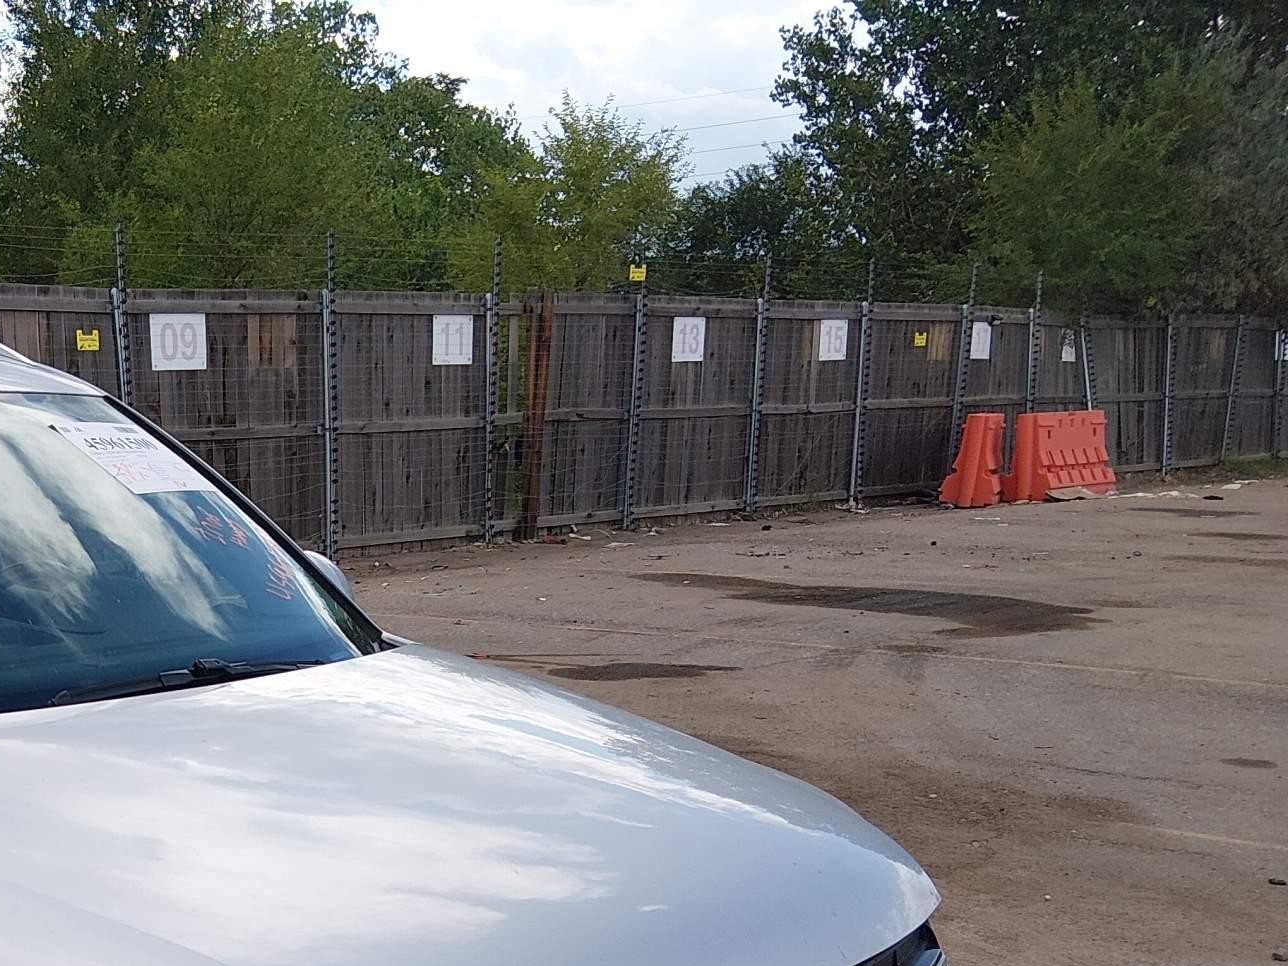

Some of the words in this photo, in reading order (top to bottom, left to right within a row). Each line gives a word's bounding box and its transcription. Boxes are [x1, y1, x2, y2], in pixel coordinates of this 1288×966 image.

[160, 322, 198, 361] 09
[441, 322, 464, 356] 11
[680, 323, 700, 354] 13
[825, 325, 844, 353] 15
